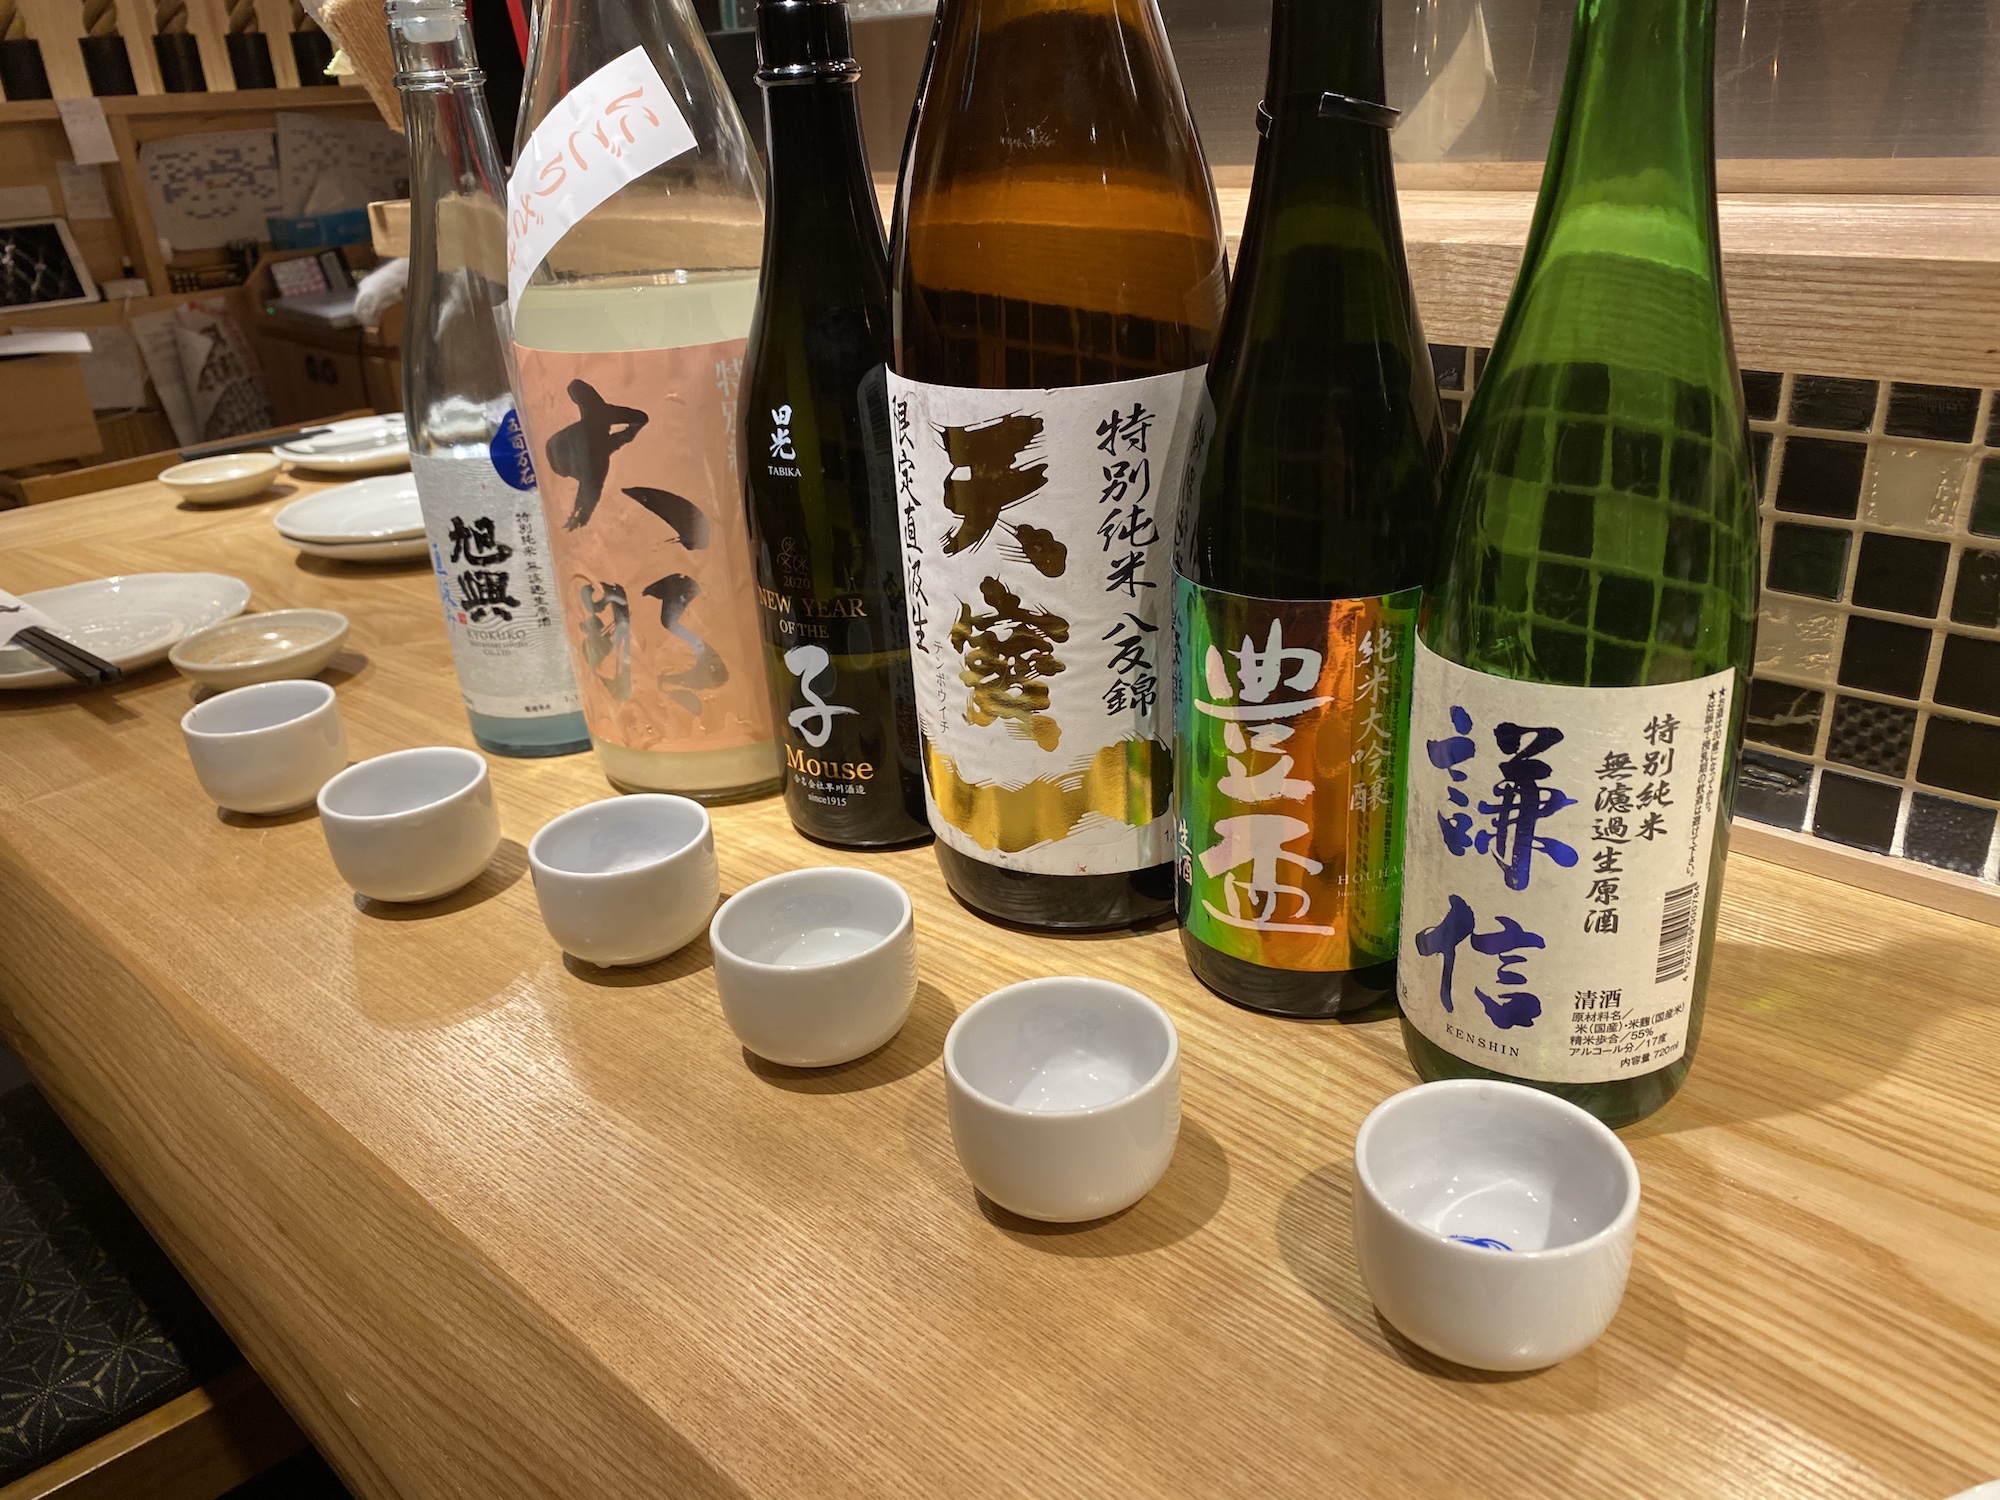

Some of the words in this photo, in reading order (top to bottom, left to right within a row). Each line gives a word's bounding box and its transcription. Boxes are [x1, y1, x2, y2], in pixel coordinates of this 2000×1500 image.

[767, 465, 802, 478] TABIKA
[1095, 402, 1161, 599] 特別純米
[448, 516, 521, 623] 旭興
[783, 575, 811, 590] 2020
[758, 585, 793, 614] NEW
[801, 597, 868, 618] YEAR
[466, 629, 526, 642] KYOKUKO
[779, 619, 796, 635] OF
[797, 623, 830, 639] THE
[1102, 611, 1159, 717] 八反錦
[783, 644, 861, 748] 子
[1348, 627, 1398, 814] 純米大吟醸
[784, 742, 875, 781] Mouse
[1635, 713, 1681, 841] 特別純米
[807, 792, 848, 807] since1915
[1583, 751, 1638, 935] 無濾過生原酒
[1416, 705, 1580, 1029] 謙信
[1574, 988, 1623, 1010] 清酒
[1446, 1023, 1520, 1058] KENSHIN
[1620, 1054, 1650, 1068] 内容量
